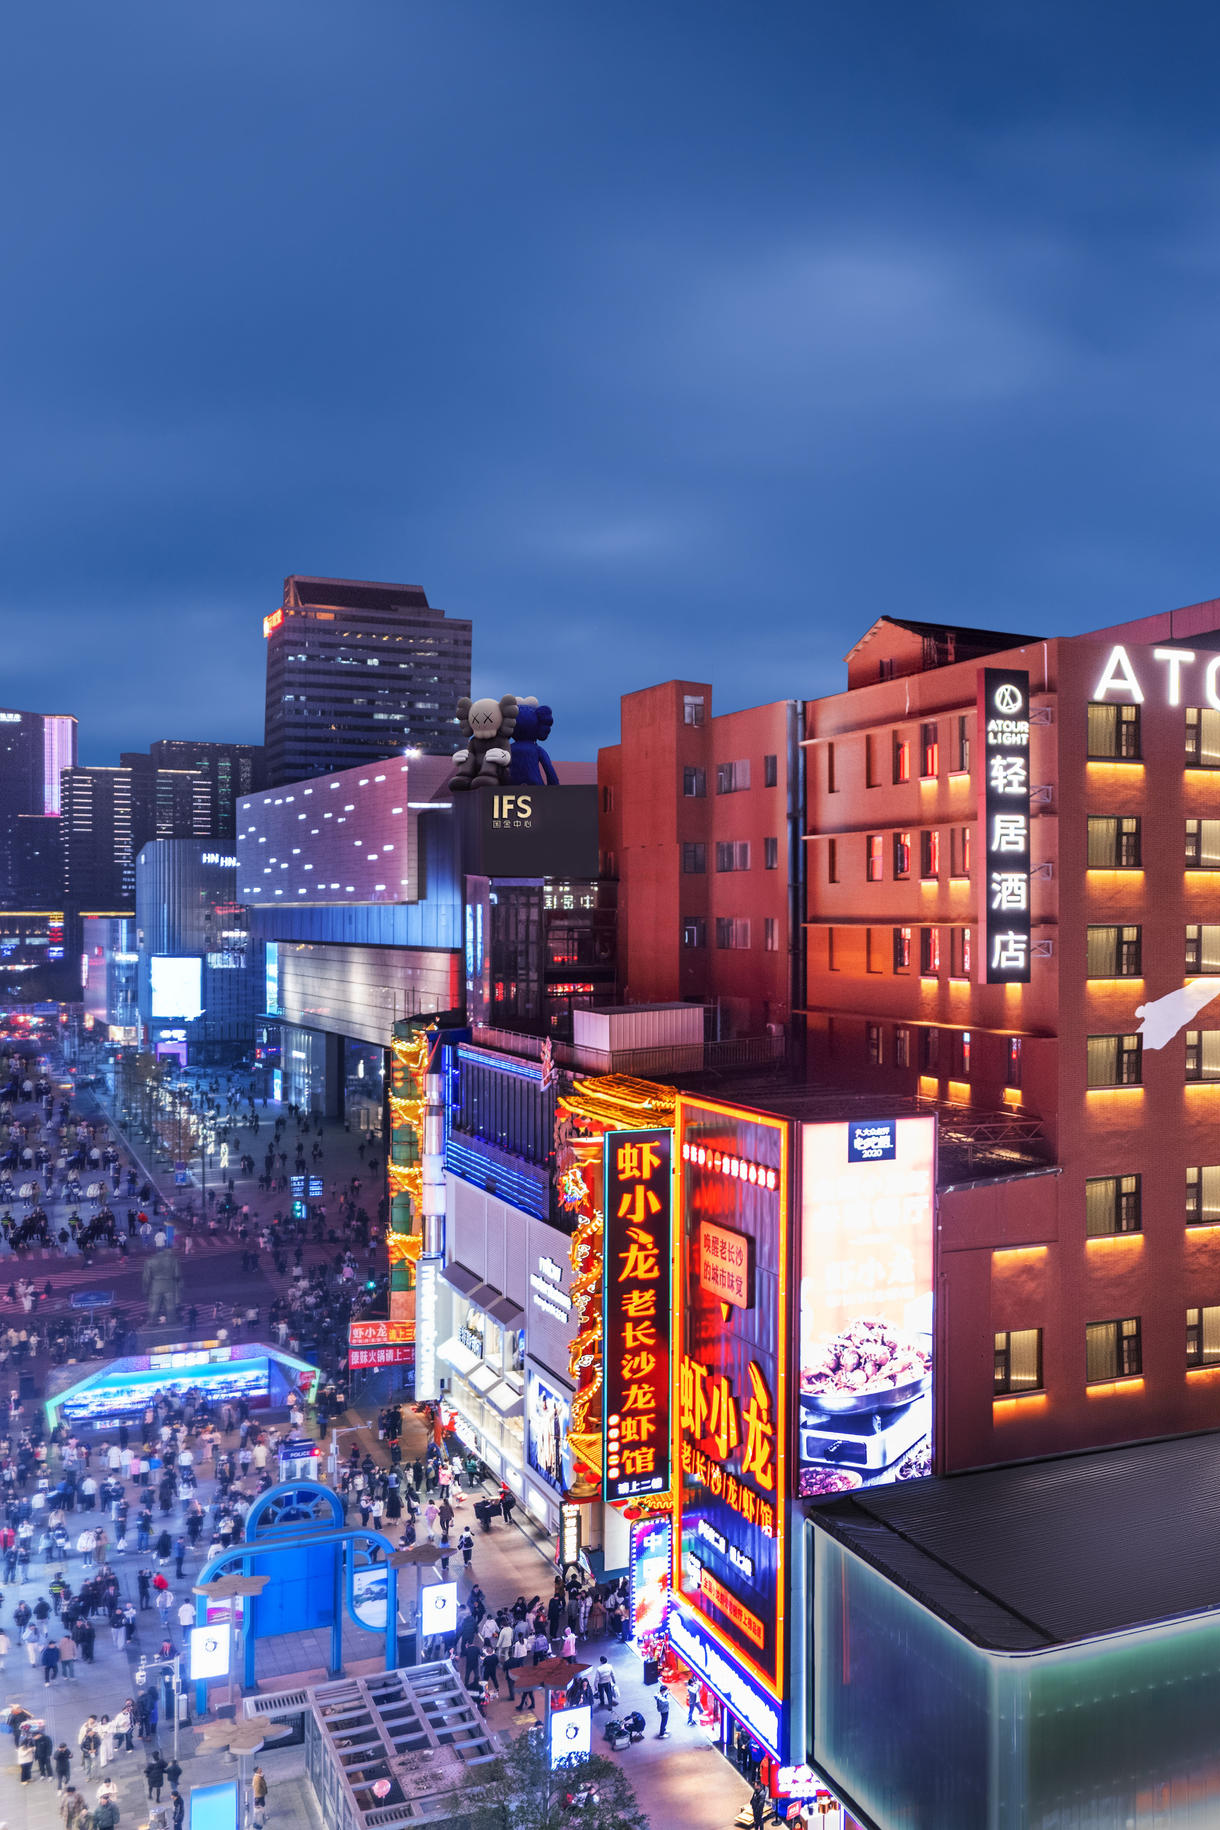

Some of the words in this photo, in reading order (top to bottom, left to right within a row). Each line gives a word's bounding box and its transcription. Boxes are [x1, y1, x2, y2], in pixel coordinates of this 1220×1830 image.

[988, 719, 1030, 733] ATOUR
[988, 732, 1030, 746] LIGHT
[493, 795, 532, 819] IFS
[989, 754, 1028, 970] 轻居酒店
[861, 1148, 883, 1159] 2020
[681, 1355, 774, 1491] 虾小龙
